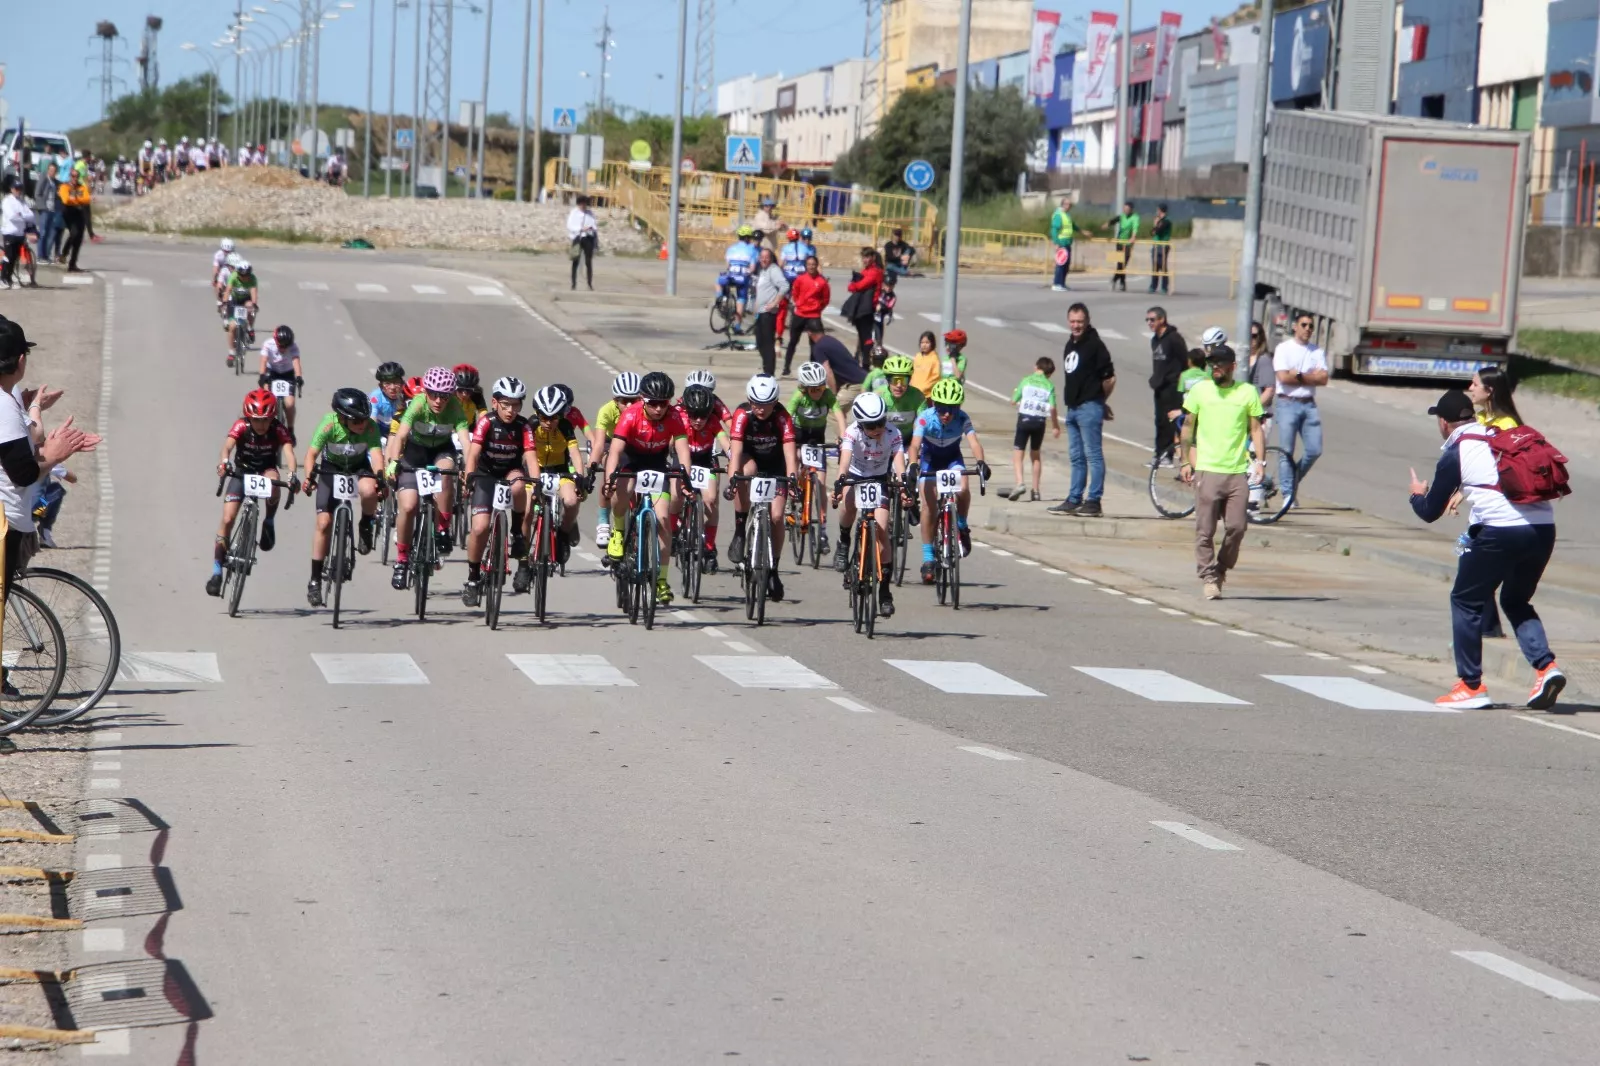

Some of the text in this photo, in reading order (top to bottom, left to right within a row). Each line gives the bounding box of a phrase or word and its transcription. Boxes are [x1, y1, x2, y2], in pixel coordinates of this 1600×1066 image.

[275, 382, 286, 393] 95
[805, 448, 818, 462] 58
[250, 476, 266, 490] 54
[421, 472, 436, 488] 53
[641, 472, 659, 489] 37
[690, 467, 705, 483] 36
[941, 472, 956, 487] 98
[338, 477, 354, 495] 38
[755, 480, 771, 497] 47
[860, 485, 877, 502] 56
[497, 486, 512, 505] 39
